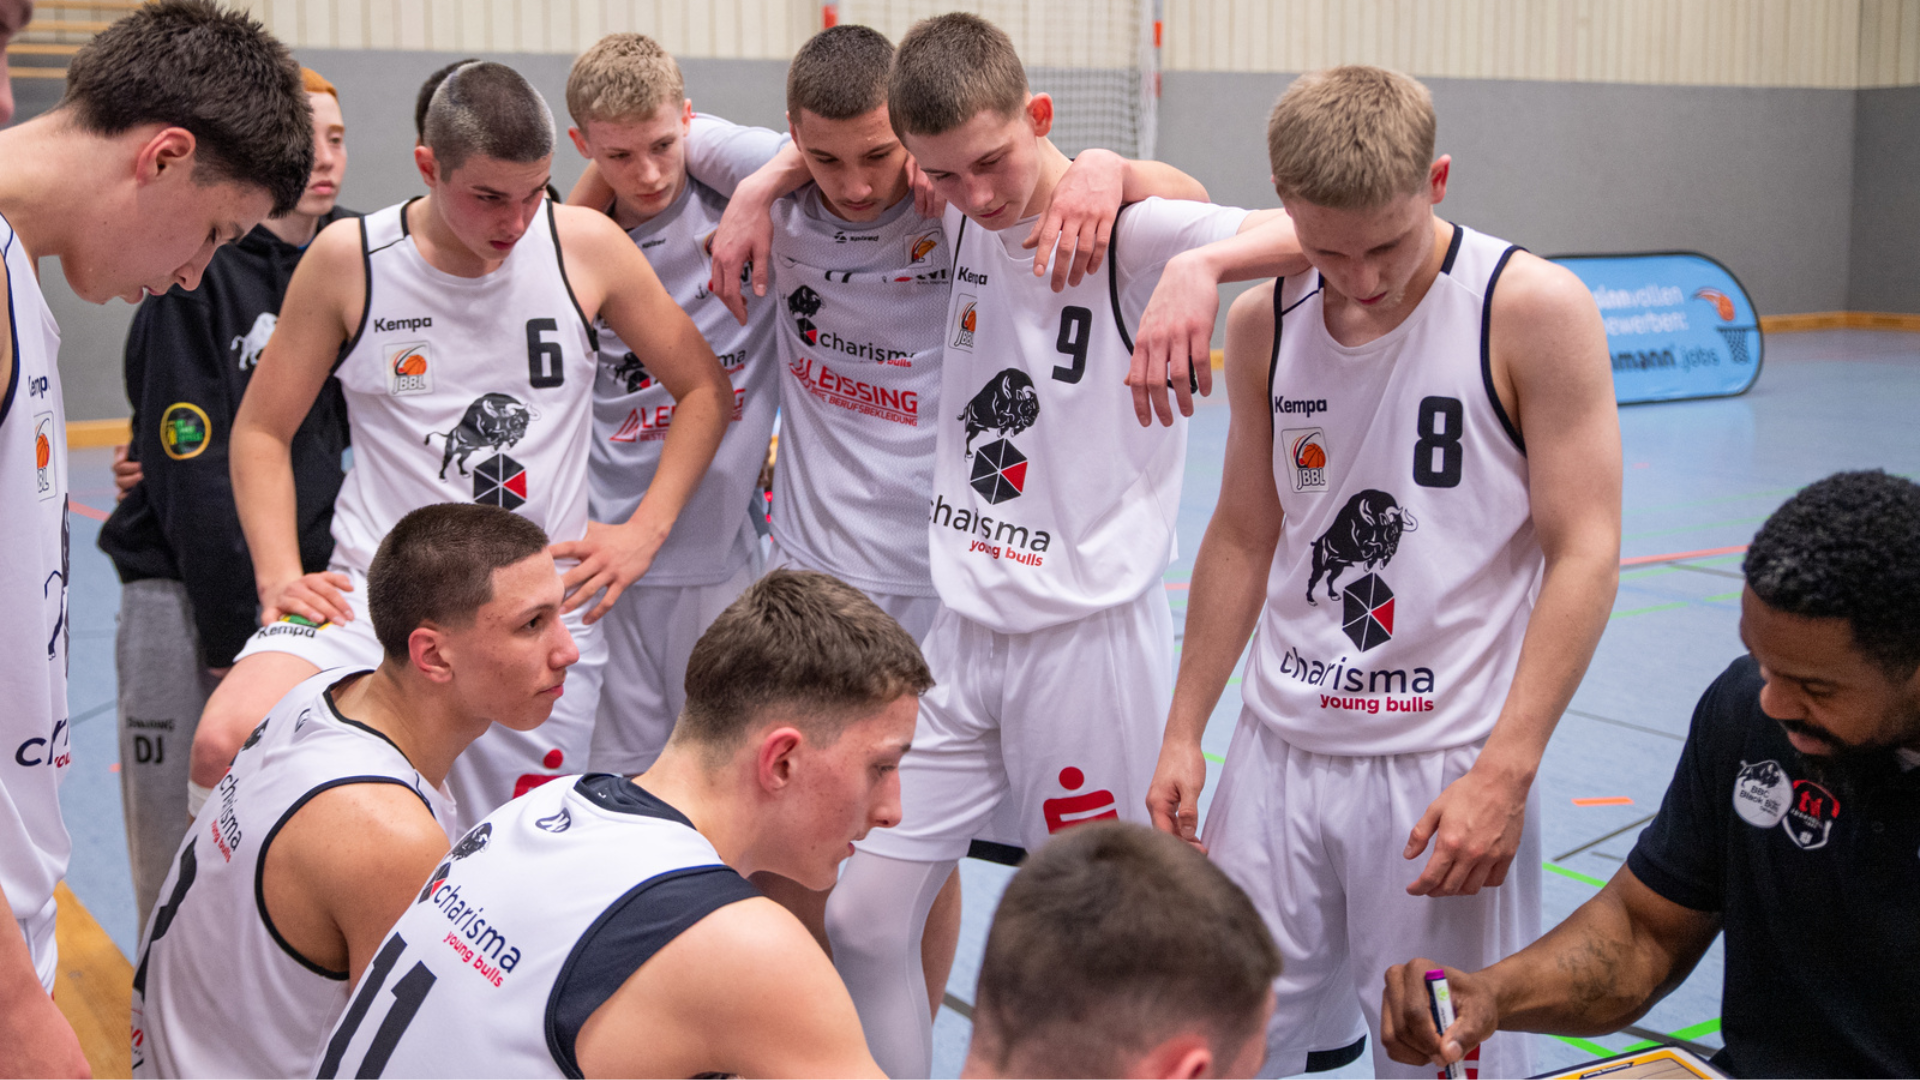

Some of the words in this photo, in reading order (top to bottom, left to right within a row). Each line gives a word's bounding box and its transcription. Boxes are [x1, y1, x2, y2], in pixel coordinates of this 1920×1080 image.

[374, 317, 433, 333] Kempa
[1603, 311, 1690, 336] ewerben:
[526, 318, 565, 389] 6
[820, 332, 917, 361] charism
[1051, 305, 1092, 384] 9
[392, 375, 427, 395] JBBL
[805, 359, 918, 414] LEISSING
[828, 395, 918, 427] BERUFSBEKLEIDUNG
[1275, 396, 1328, 418] Kempa
[1413, 396, 1463, 488] 8
[1296, 468, 1327, 490] JBBL
[1005, 547, 1043, 567] bulls
[1280, 646, 1435, 694] charisma
[1320, 694, 1380, 714] young
[1386, 696, 1434, 712] bulls
[134, 735, 164, 764] DJ
[1739, 789, 1763, 804] Black
[1750, 785, 1770, 798] BBC
[433, 884, 522, 974] charisma
[443, 930, 475, 964] young
[473, 955, 504, 988] bulls
[315, 931, 437, 1079] 11
